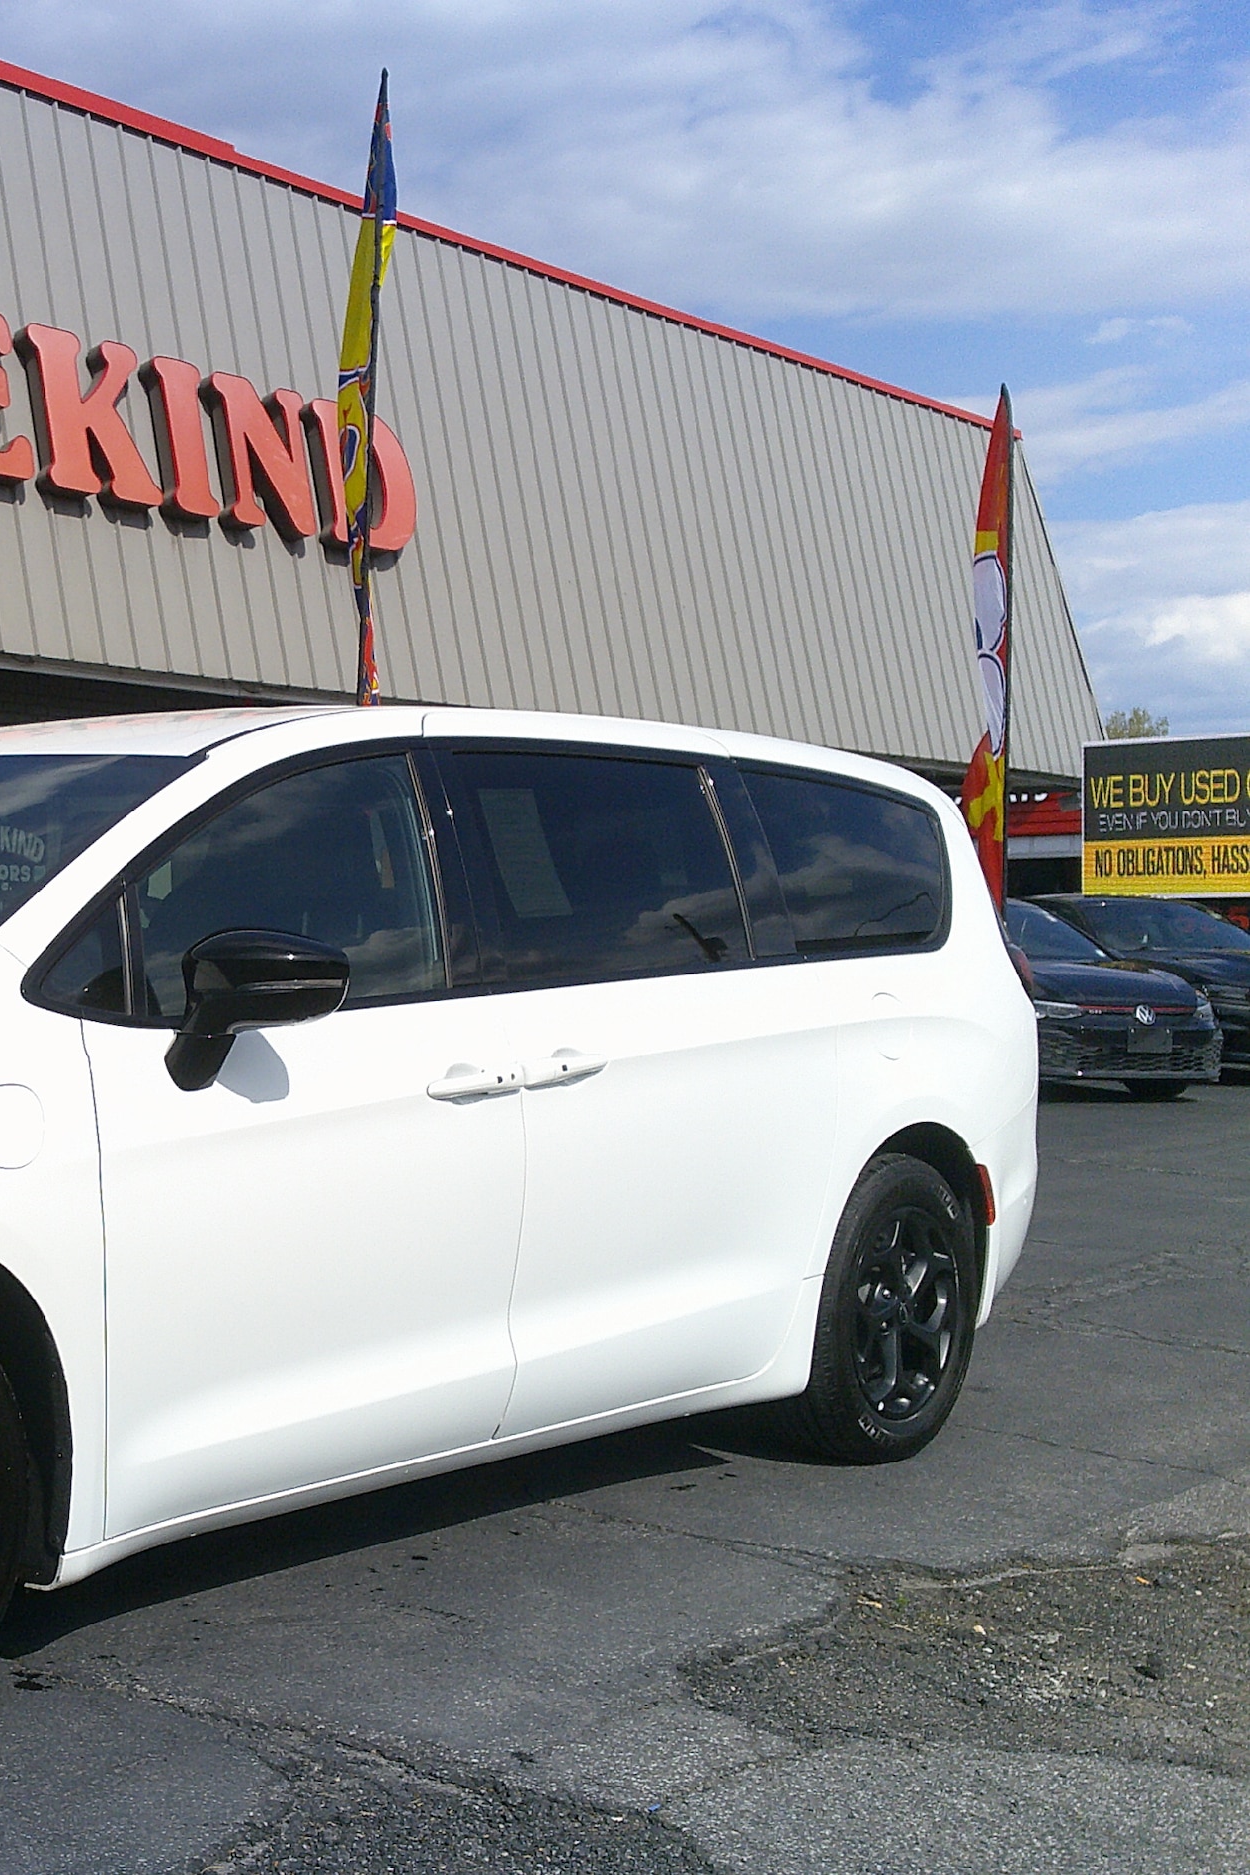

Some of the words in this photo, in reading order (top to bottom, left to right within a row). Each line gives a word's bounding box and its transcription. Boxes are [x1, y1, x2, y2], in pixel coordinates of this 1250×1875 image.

[1090, 775, 1123, 809] WE
[1130, 772, 1175, 807] BUY
[1181, 769, 1241, 805] USED
[1099, 812, 1133, 832] EVEN
[1136, 811, 1147, 830] IF
[1151, 810, 1178, 830] YOU
[1182, 809, 1223, 829] DON'T
[1095, 848, 1113, 878] NO
[1117, 844, 1207, 879] OBLIGATIONS,
